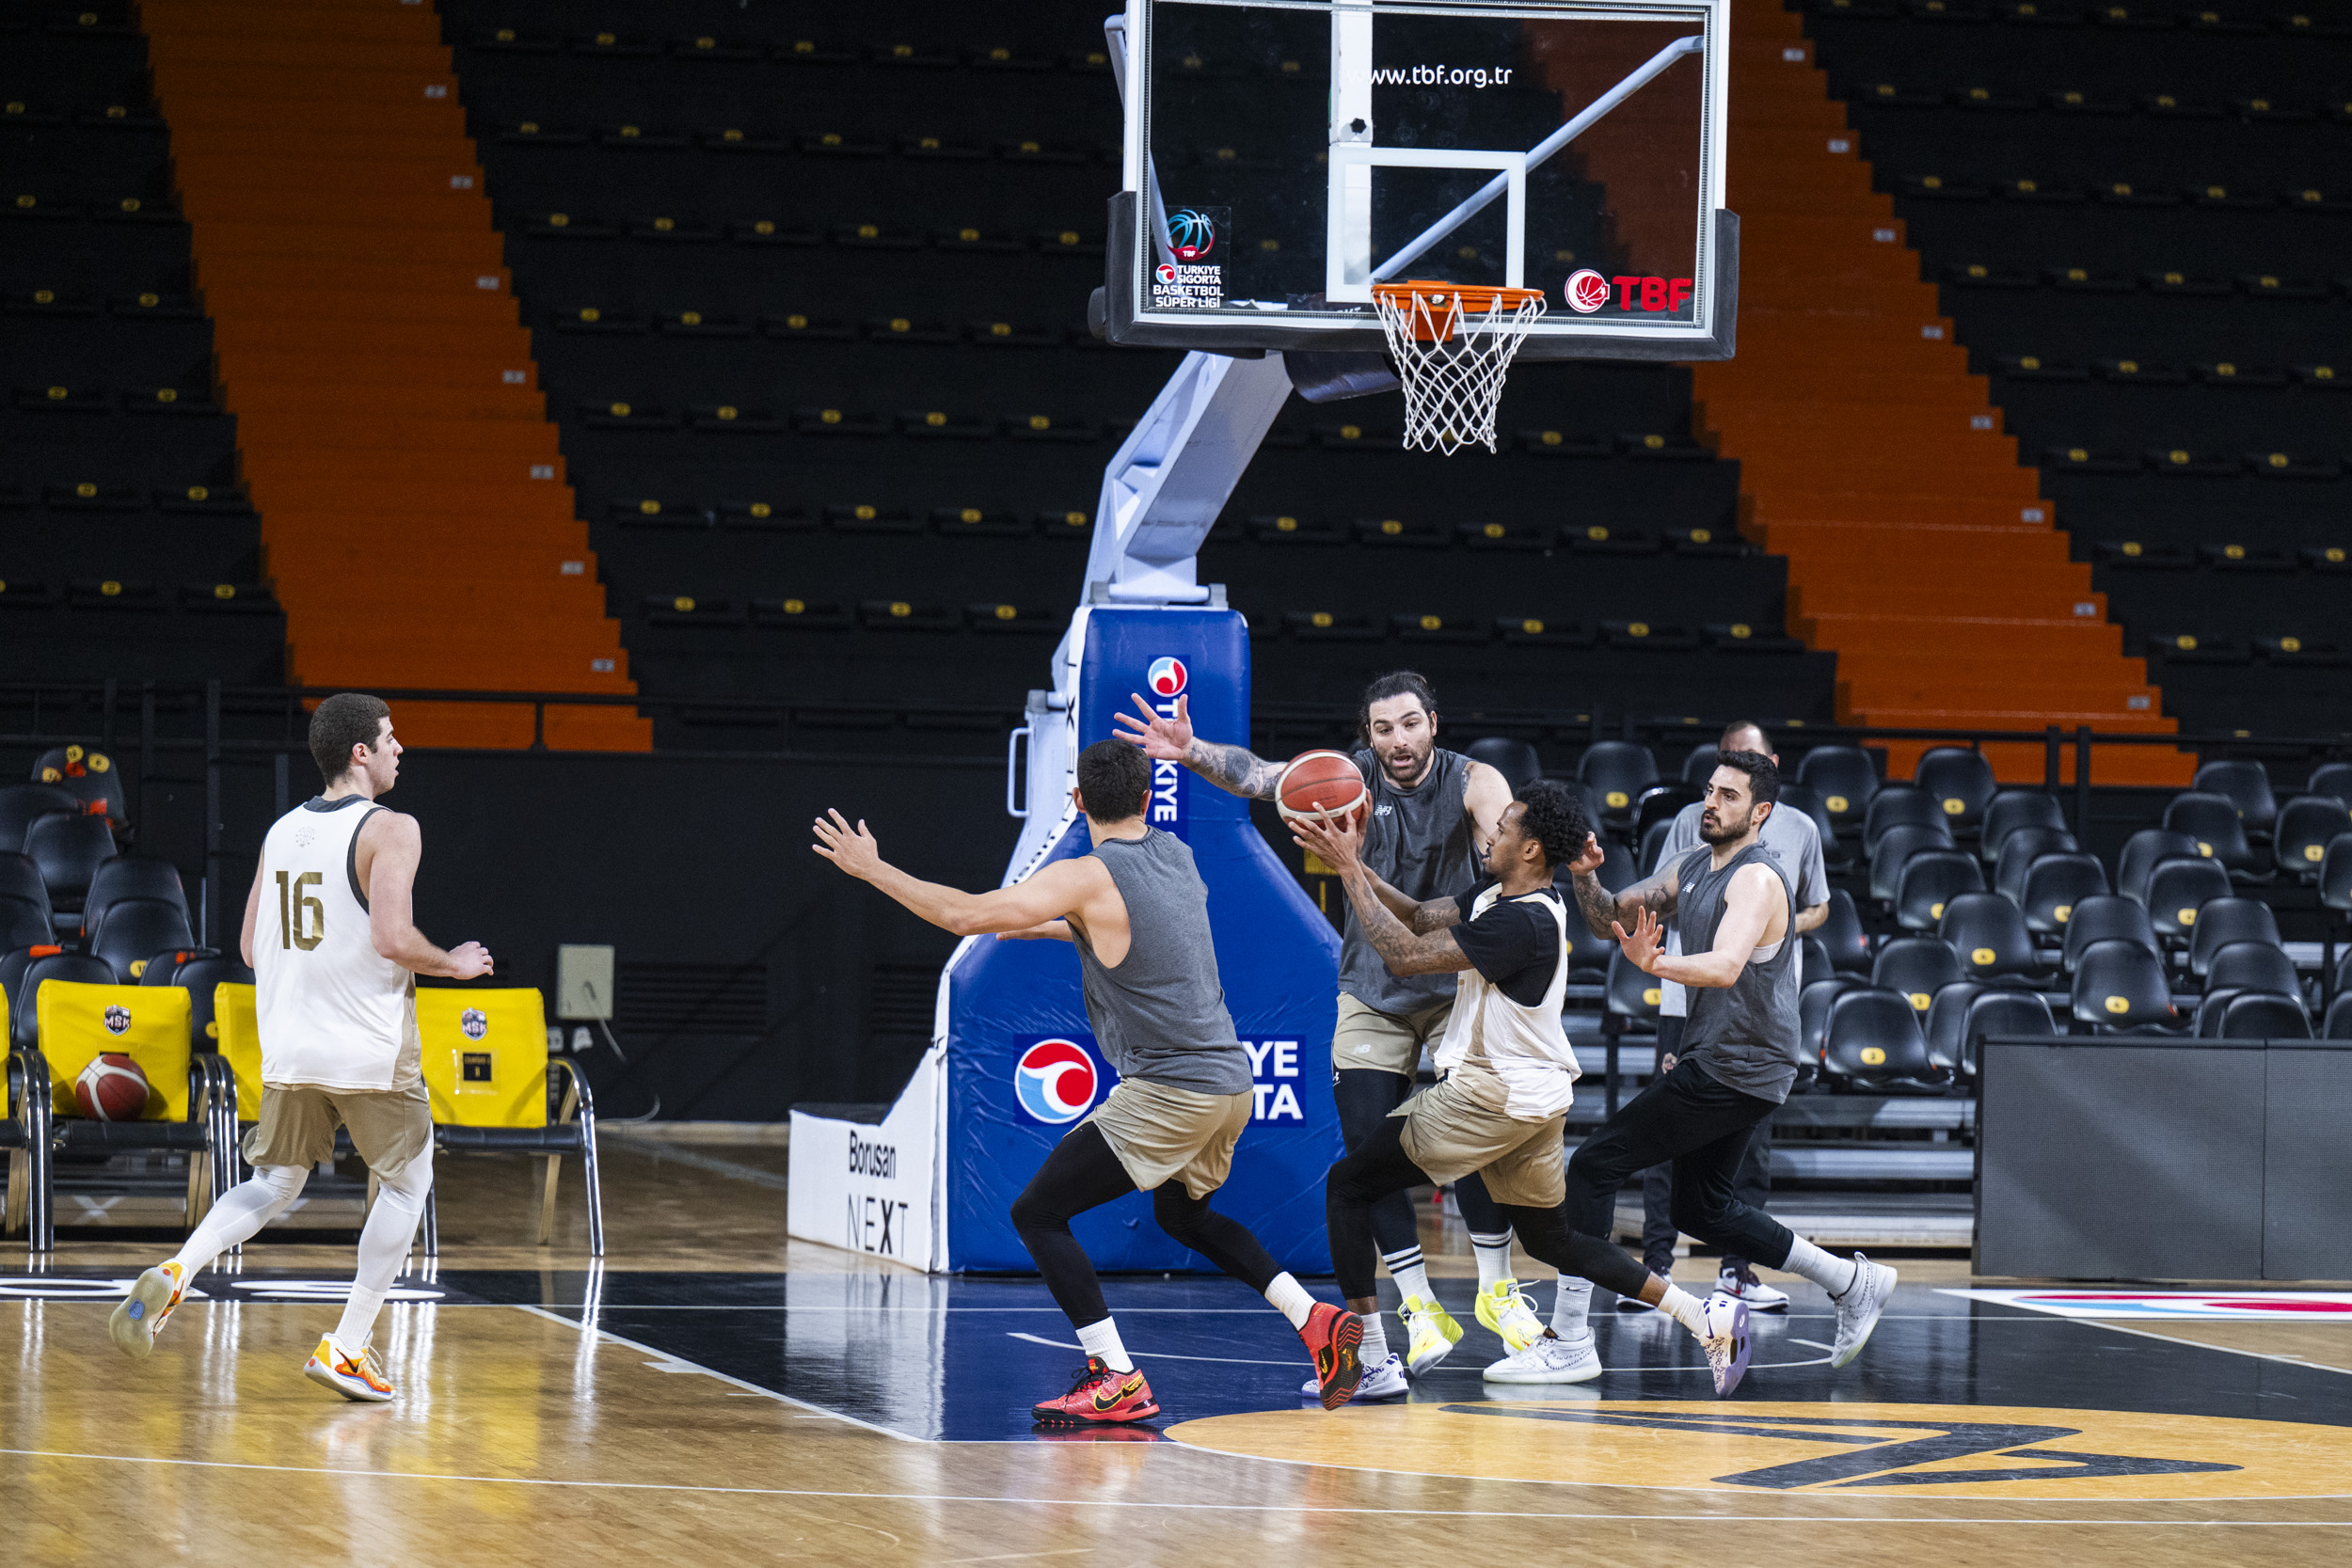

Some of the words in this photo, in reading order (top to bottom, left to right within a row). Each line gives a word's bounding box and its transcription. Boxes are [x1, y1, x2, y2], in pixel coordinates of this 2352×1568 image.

[1347, 64, 1513, 88] ww.tbf.org.tr
[1152, 285, 1224, 296] BASKETBOL
[1612, 276, 1692, 312] TBF
[276, 871, 324, 951] 16
[850, 1129, 897, 1180] Borusan
[848, 1193, 909, 1259] NEXT
